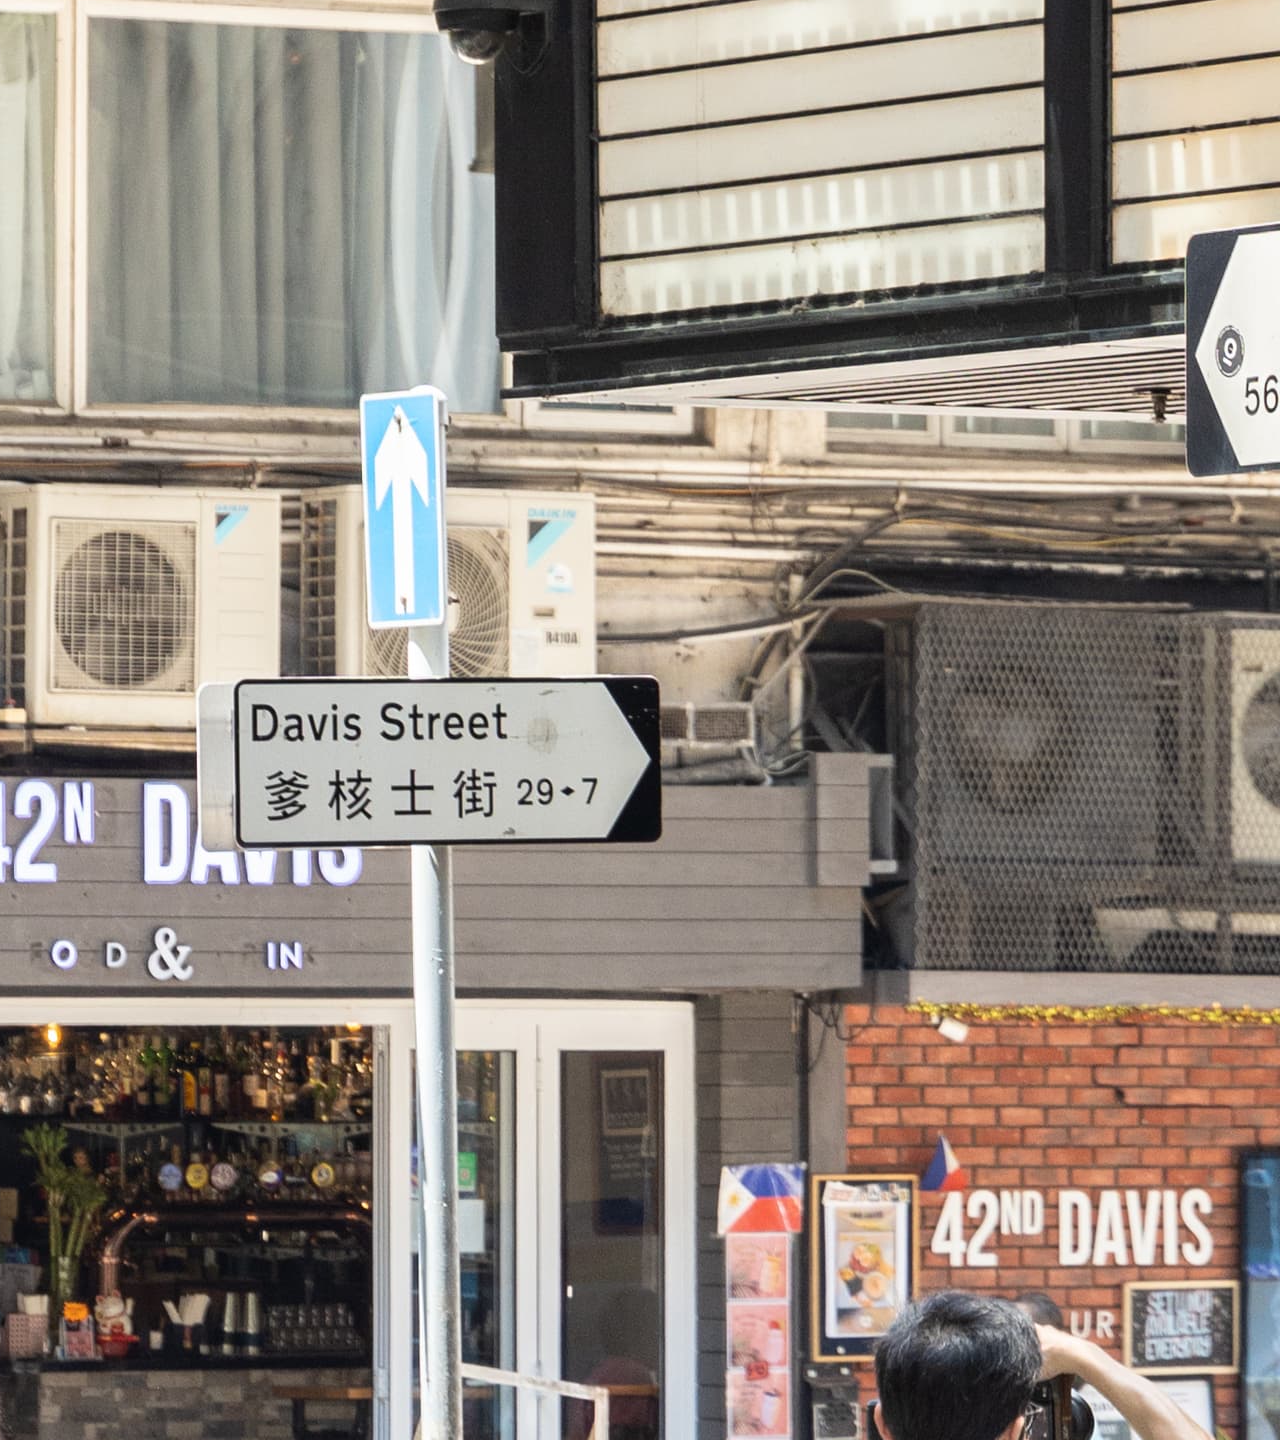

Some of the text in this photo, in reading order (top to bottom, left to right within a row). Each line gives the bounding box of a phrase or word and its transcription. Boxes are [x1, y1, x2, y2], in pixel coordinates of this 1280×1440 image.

[251, 703, 509, 742] Davis Street
[263, 768, 498, 821] 爹核士街
[930, 1188, 1215, 1267] 42ND DAVIS
